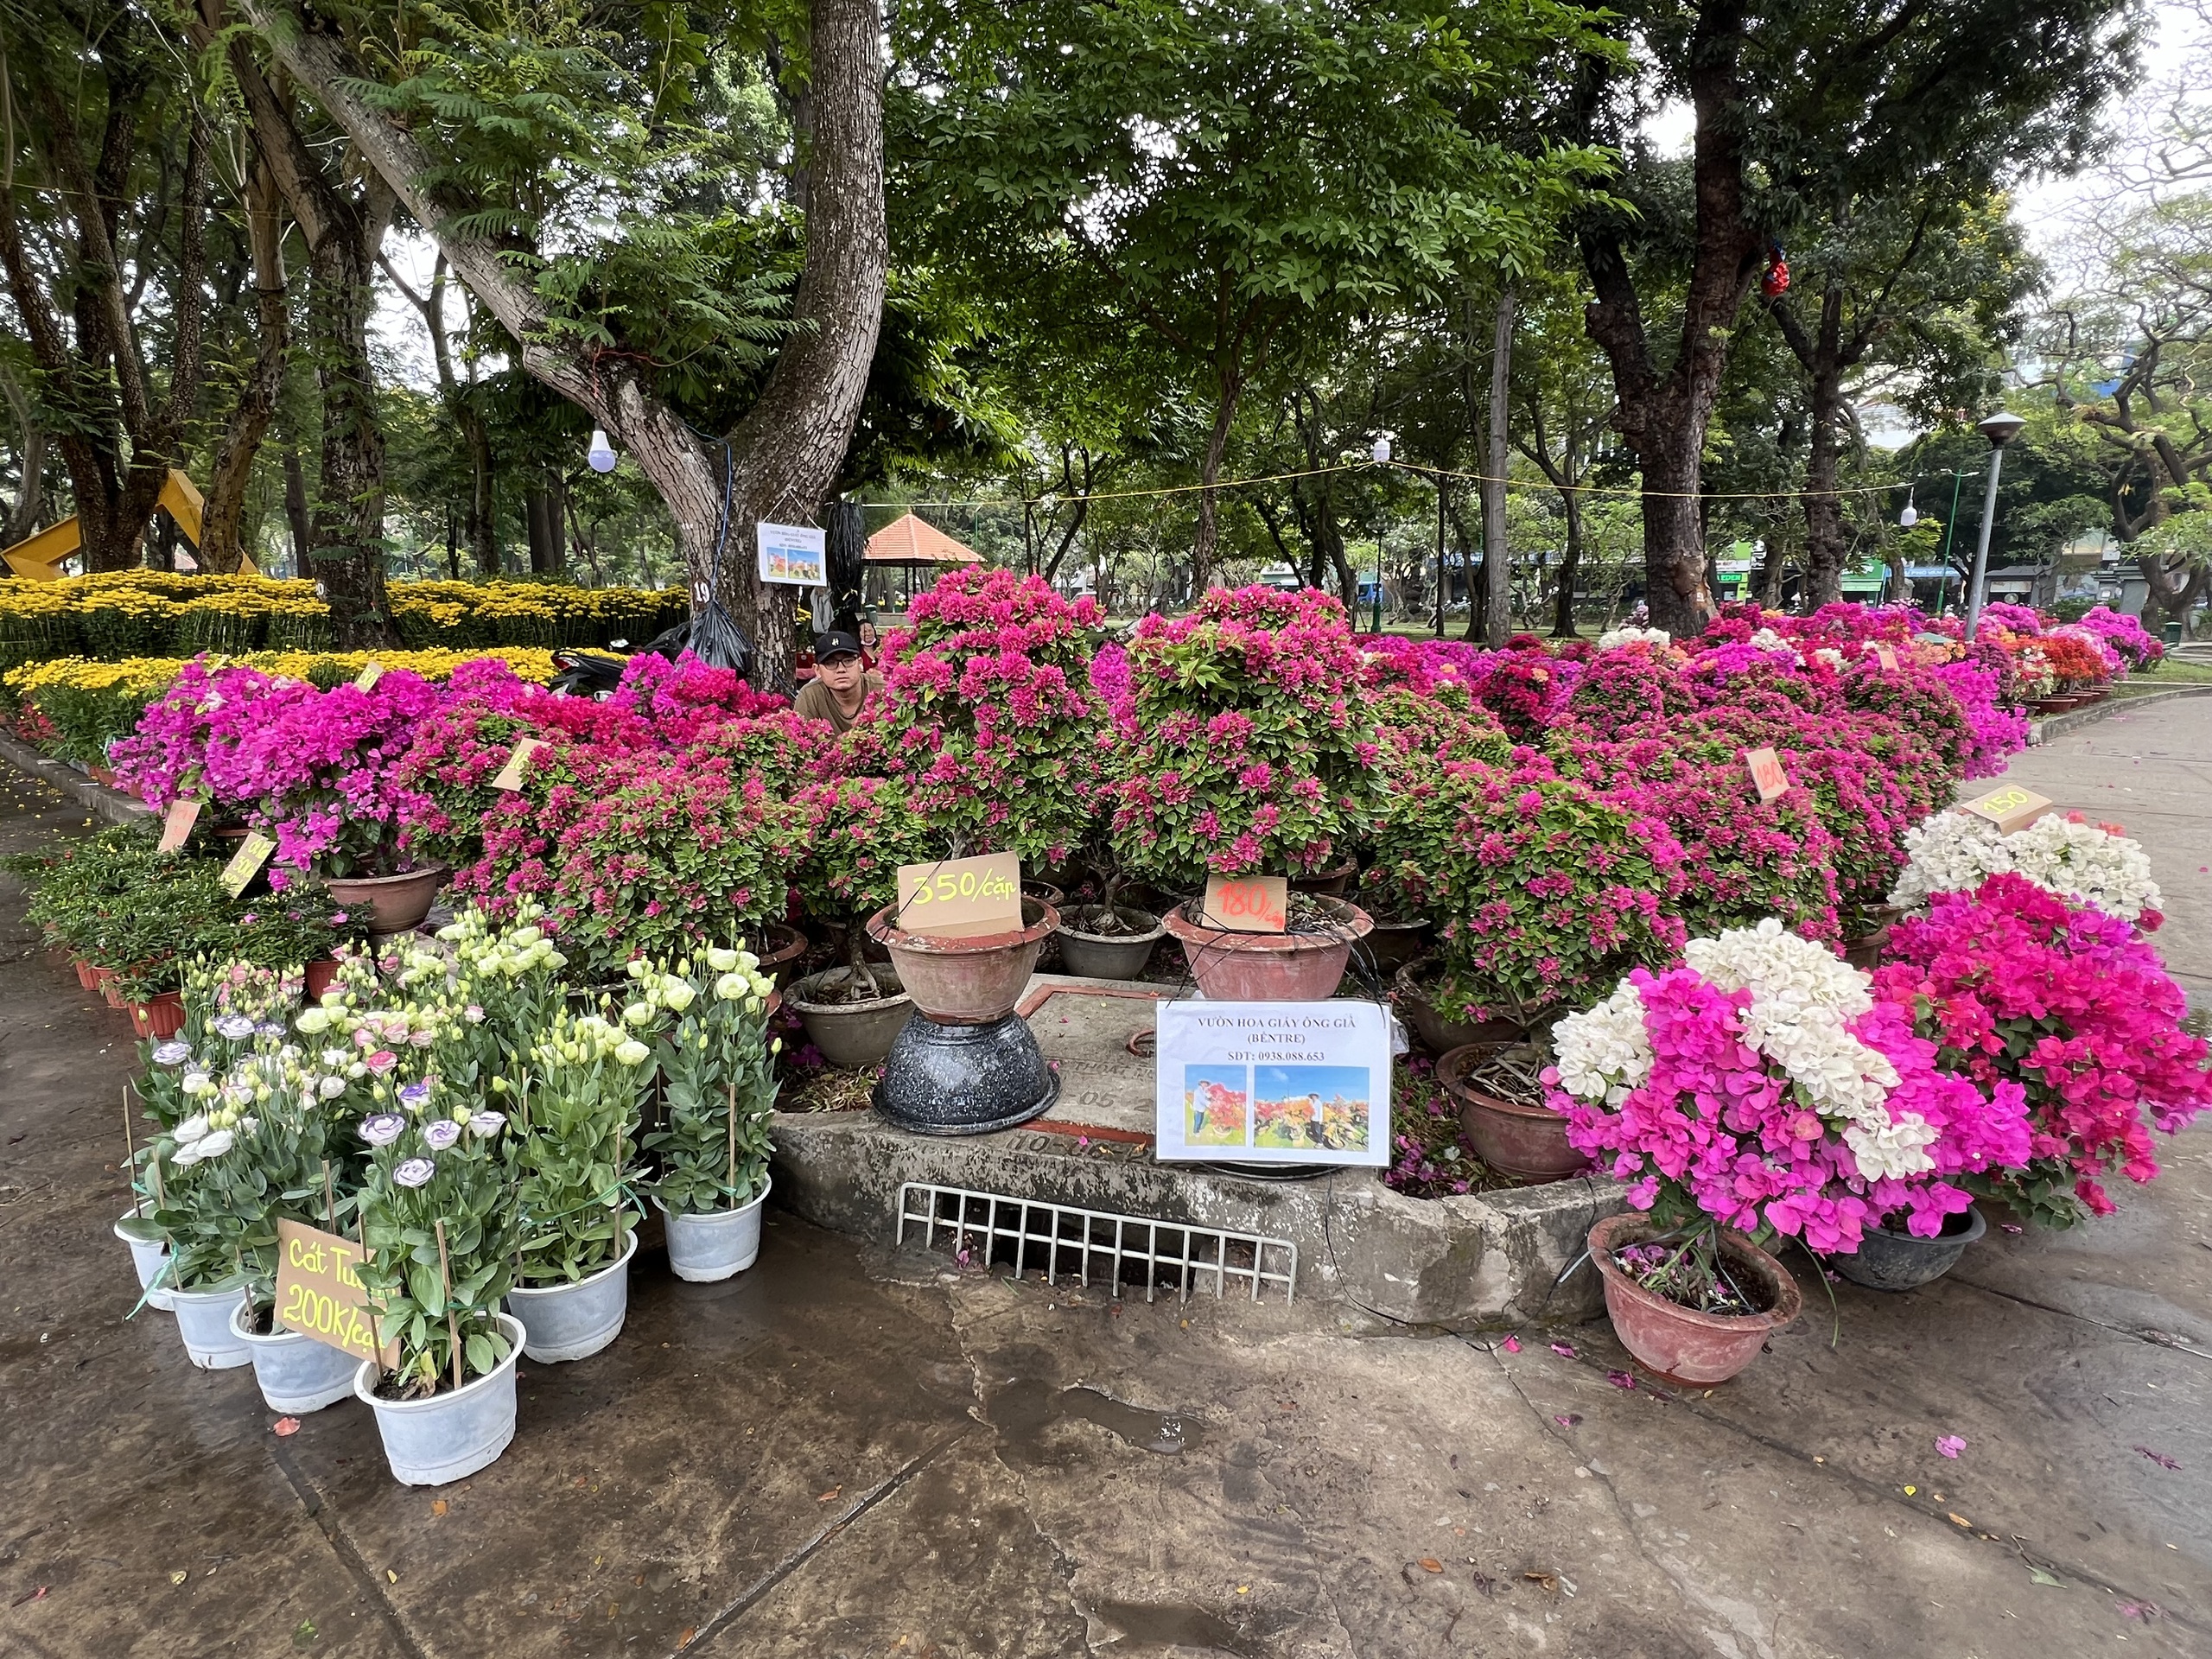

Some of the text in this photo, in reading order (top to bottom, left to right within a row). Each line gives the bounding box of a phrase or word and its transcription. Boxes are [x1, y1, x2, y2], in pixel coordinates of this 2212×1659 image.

[694, 581, 710, 603] 19
[1756, 759, 1784, 791] 180
[1982, 790, 2029, 816] 150
[912, 868, 1017, 905] 350/cặp
[1237, 1018, 1265, 1027] HOA
[1302, 1015, 1330, 1028] ÔNG
[1258, 1051, 1325, 1062] 0938.088.653
